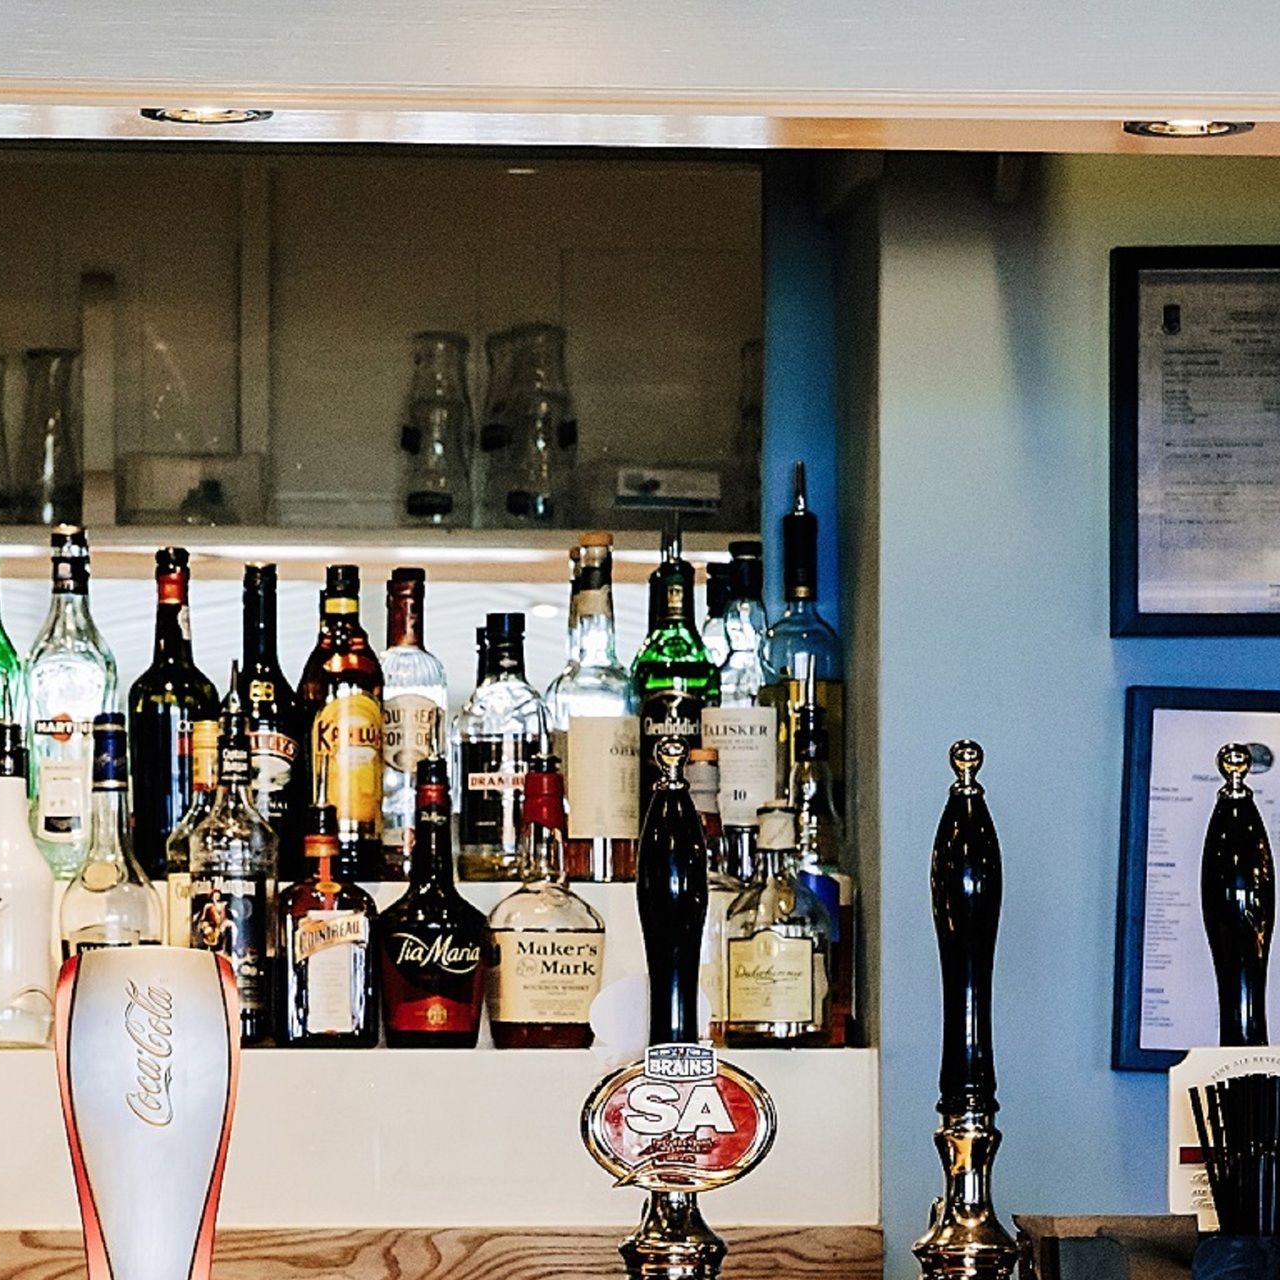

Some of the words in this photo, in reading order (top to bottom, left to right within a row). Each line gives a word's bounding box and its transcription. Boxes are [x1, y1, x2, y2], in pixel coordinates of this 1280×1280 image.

[704, 723, 768, 736] TALISKER
[391, 932, 424, 965] Tia
[422, 932, 480, 969] Maria
[516, 941, 598, 956] Maker's
[541, 960, 596, 976] Mark
[649, 1059, 712, 1076] BRAINS
[625, 1082, 736, 1135] SA
